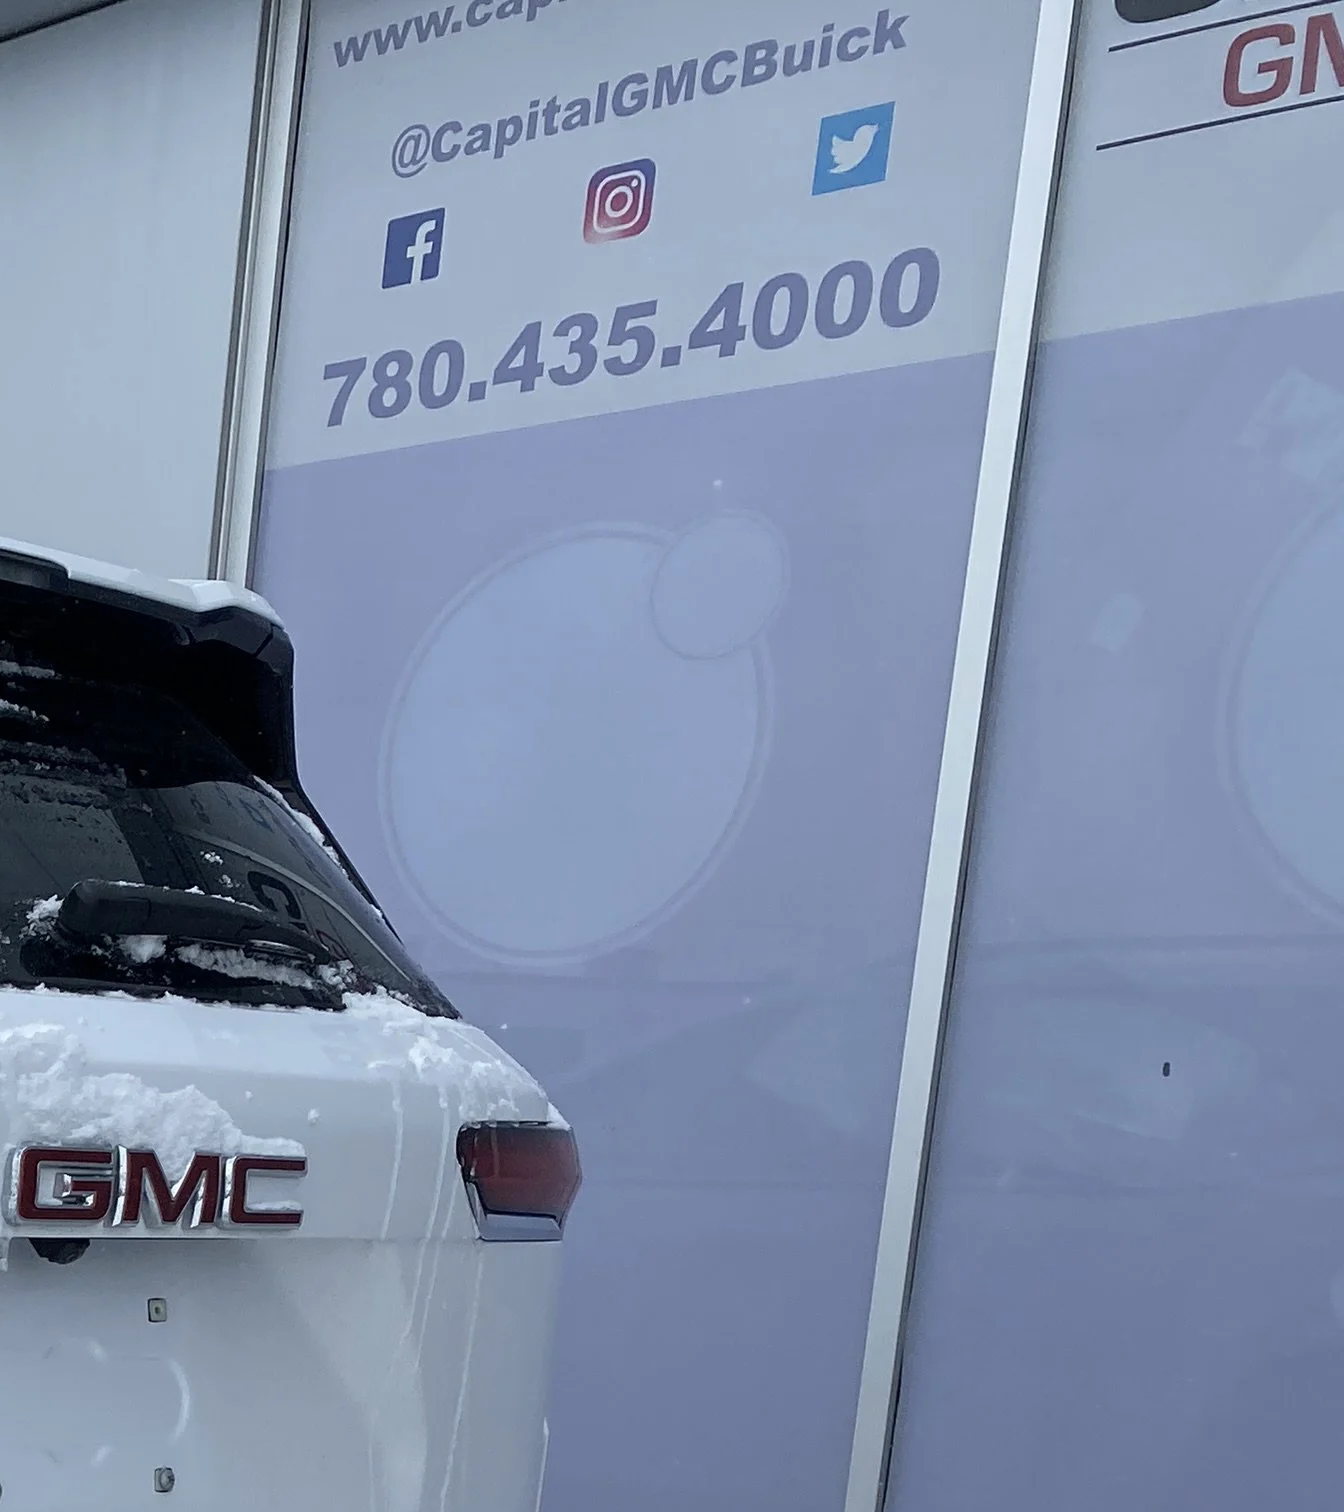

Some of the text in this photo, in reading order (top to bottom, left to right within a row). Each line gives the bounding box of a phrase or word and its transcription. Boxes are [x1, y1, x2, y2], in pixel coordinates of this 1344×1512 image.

[334, 0, 568, 68] www.cap
[392, 9, 909, 178] @CapitalGMCBuick
[322, 247, 941, 427] 780.435.4000
[4, 1142, 308, 1229] GMC
